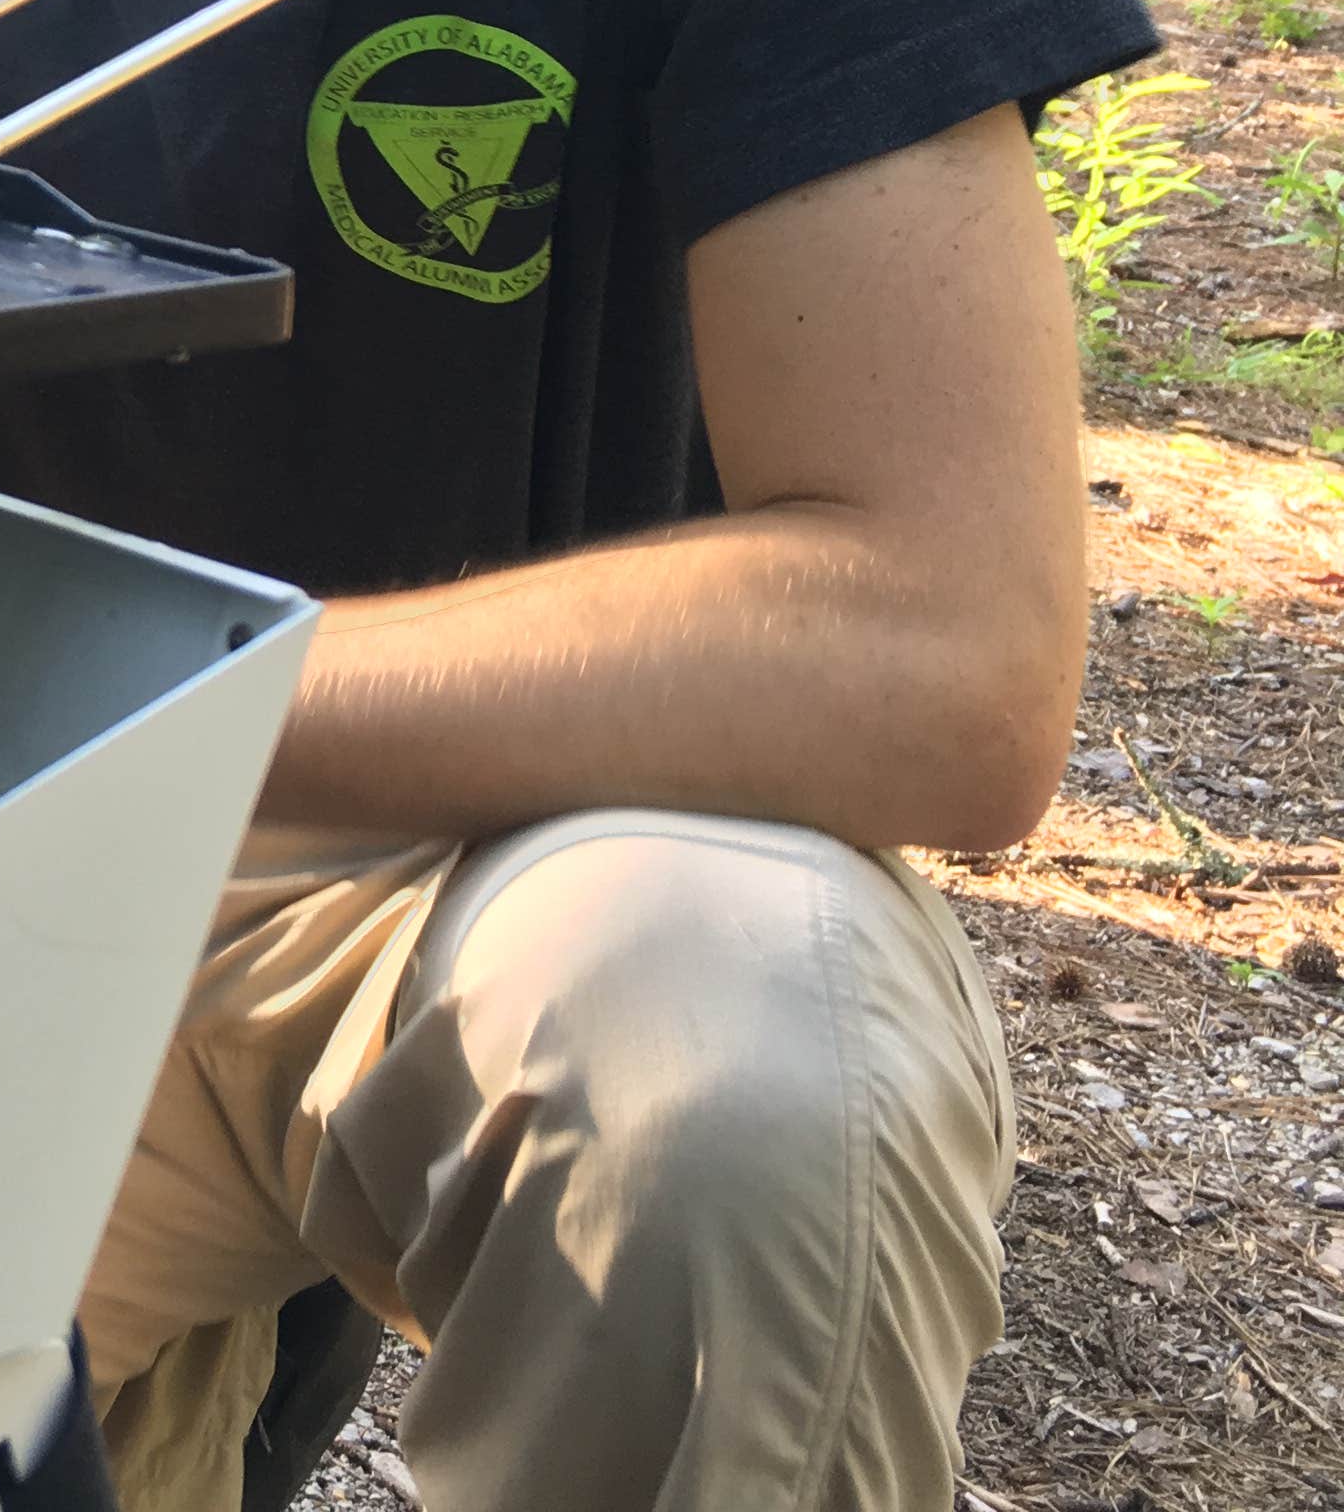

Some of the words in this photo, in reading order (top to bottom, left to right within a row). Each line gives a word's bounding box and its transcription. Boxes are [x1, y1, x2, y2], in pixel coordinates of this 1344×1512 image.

[320, 28, 428, 113] UNIVERSITY
[437, 26, 464, 46] OF
[466, 34, 576, 105] ALABAMA
[327, 182, 397, 267] MEDICAL
[401, 259, 493, 296] ALUMNI
